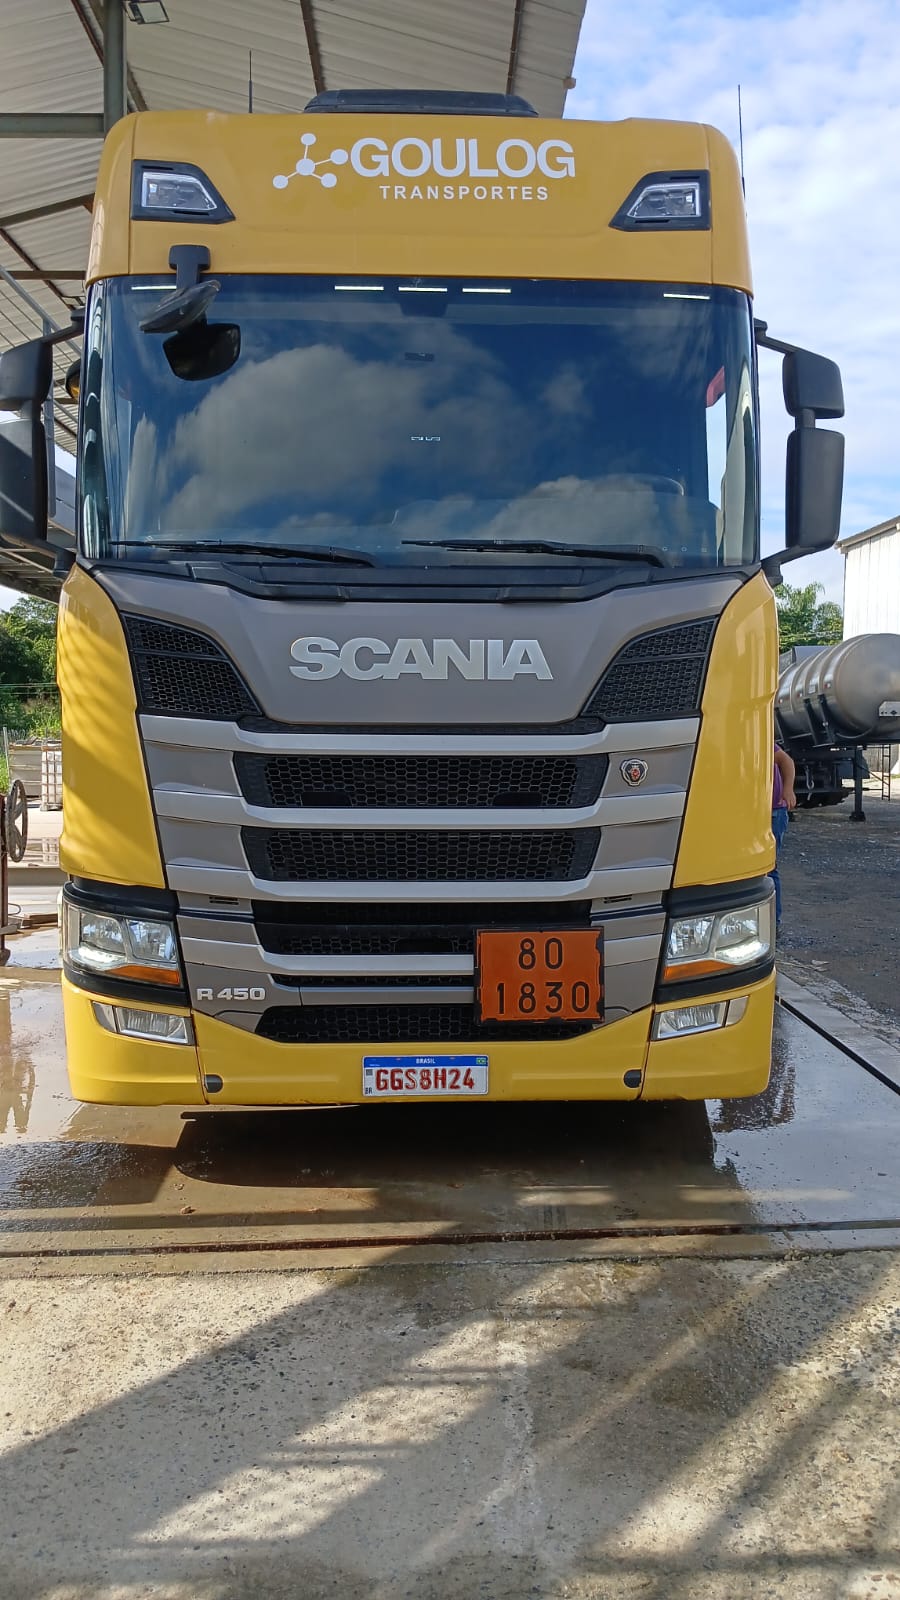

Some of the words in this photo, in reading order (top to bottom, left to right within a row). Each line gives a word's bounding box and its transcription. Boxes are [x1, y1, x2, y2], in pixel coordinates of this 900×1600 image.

[350, 137, 576, 178] GOULOG
[379, 185, 549, 201] TRANSPORTES
[289, 636, 554, 680] SCANIA
[518, 937, 563, 970] 80
[196, 988, 213, 1001] R
[217, 987, 266, 1001] 450
[497, 981, 590, 1014] 1830
[375, 1068, 475, 1091] GGS8H24
